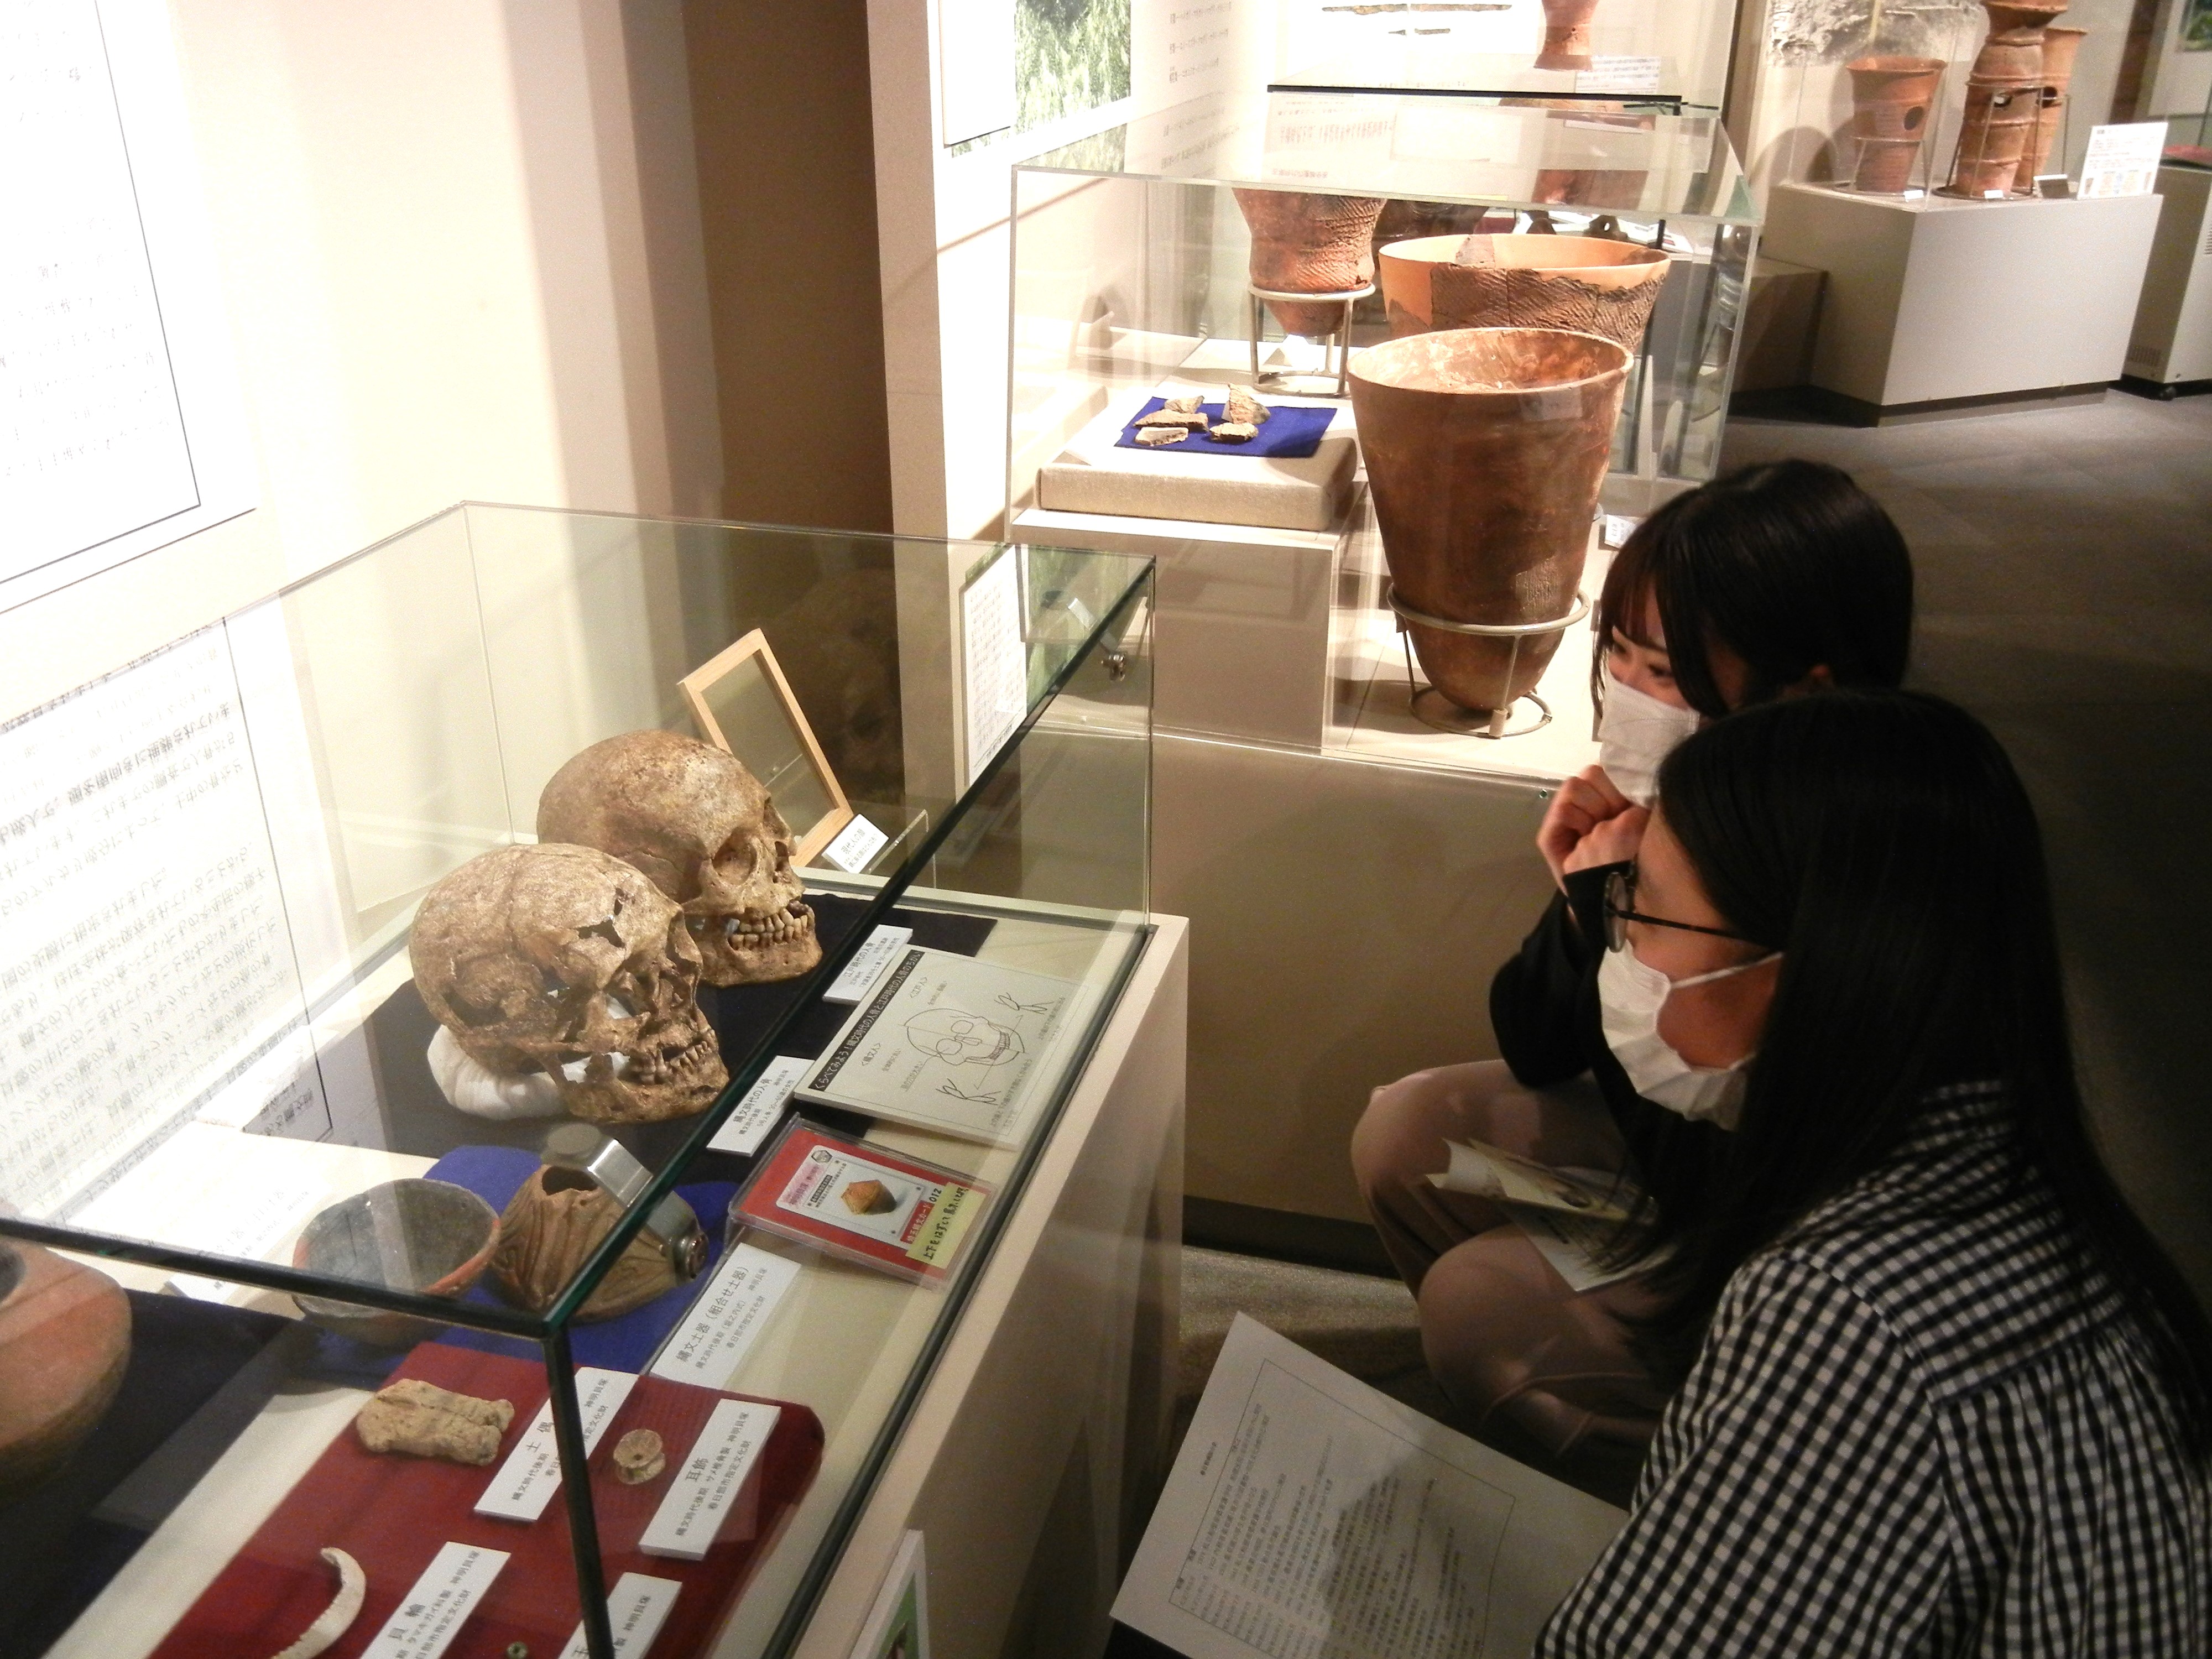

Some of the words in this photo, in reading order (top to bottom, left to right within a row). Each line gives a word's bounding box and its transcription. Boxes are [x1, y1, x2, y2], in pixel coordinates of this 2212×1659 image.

[674, 1264, 751, 1362] 縄文土器（組合せ土器）
[684, 1457, 710, 1482] 耳飾
